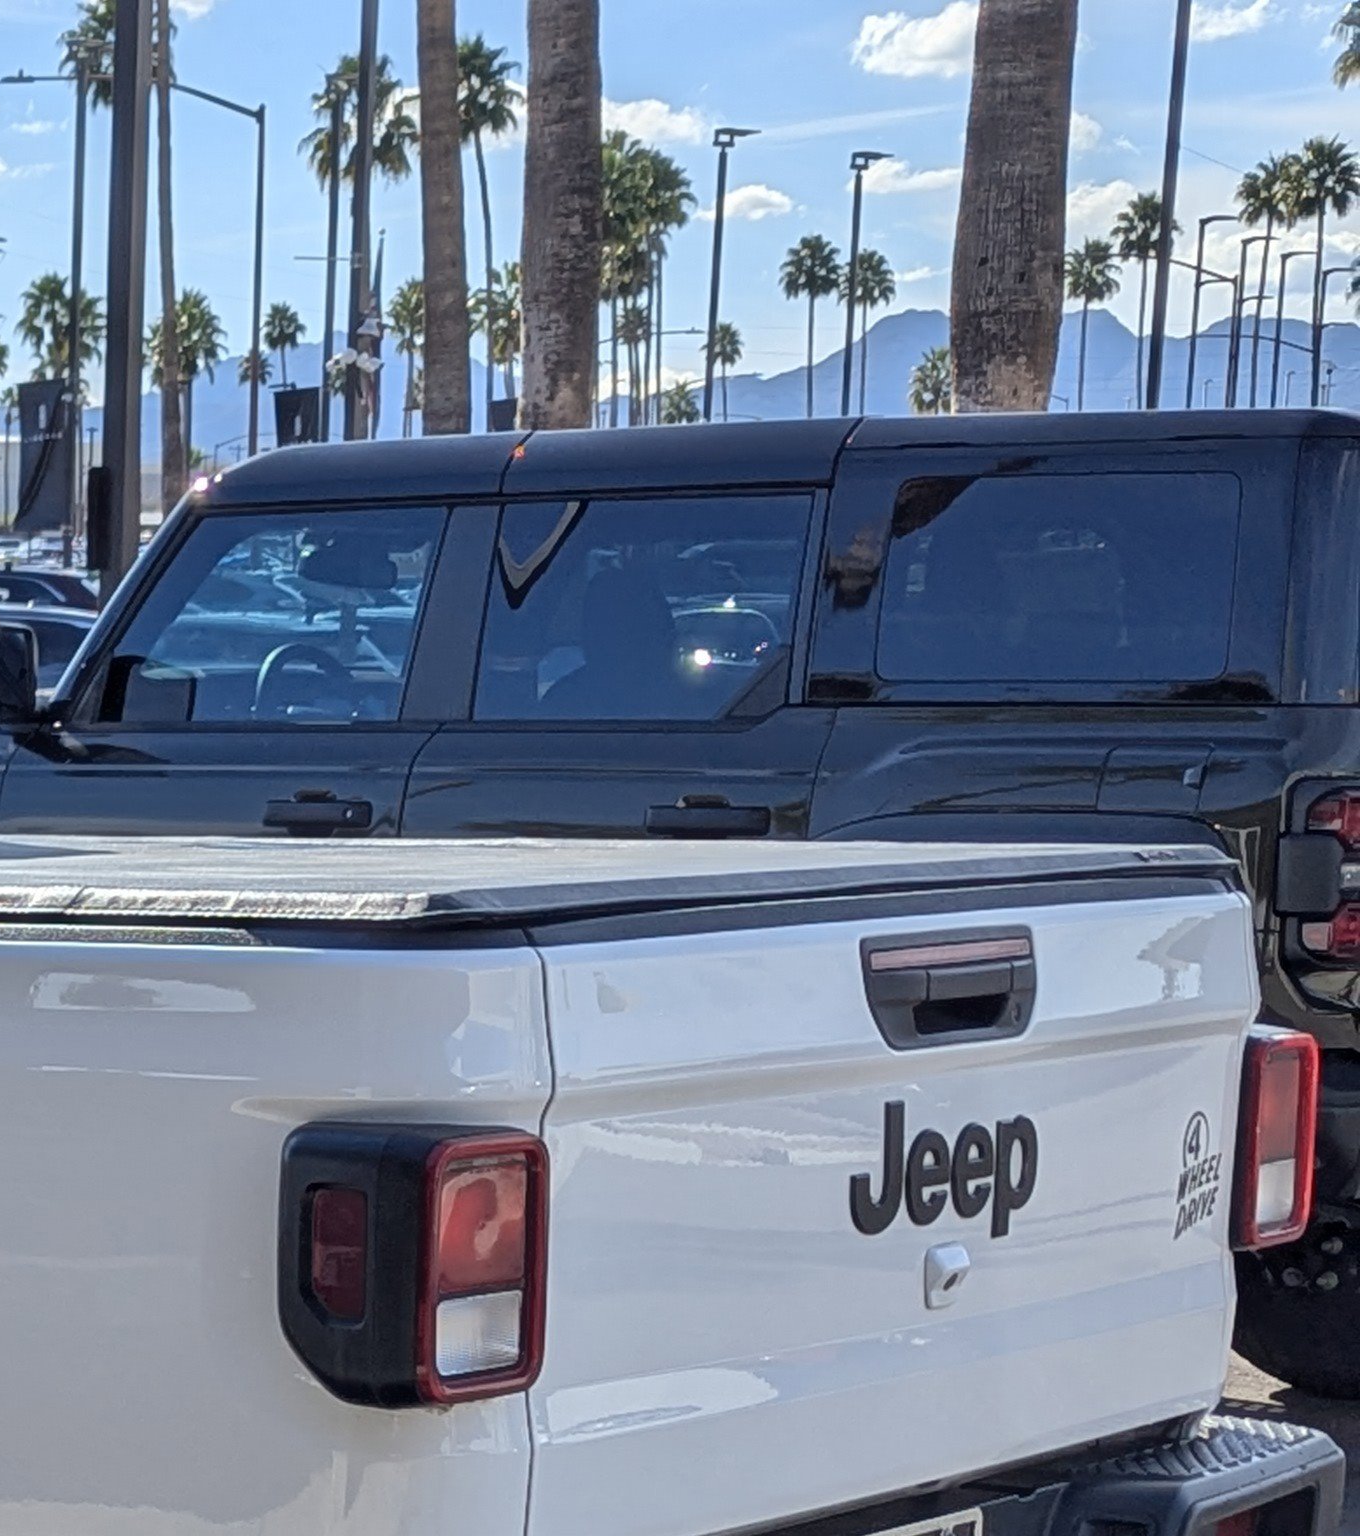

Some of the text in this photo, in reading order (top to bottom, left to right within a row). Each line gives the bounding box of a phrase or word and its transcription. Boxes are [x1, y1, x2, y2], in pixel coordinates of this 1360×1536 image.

[849, 1100, 1039, 1239] Jeep
[1176, 1153, 1222, 1204] WHEEL
[1173, 1186, 1219, 1240] DRIVE
